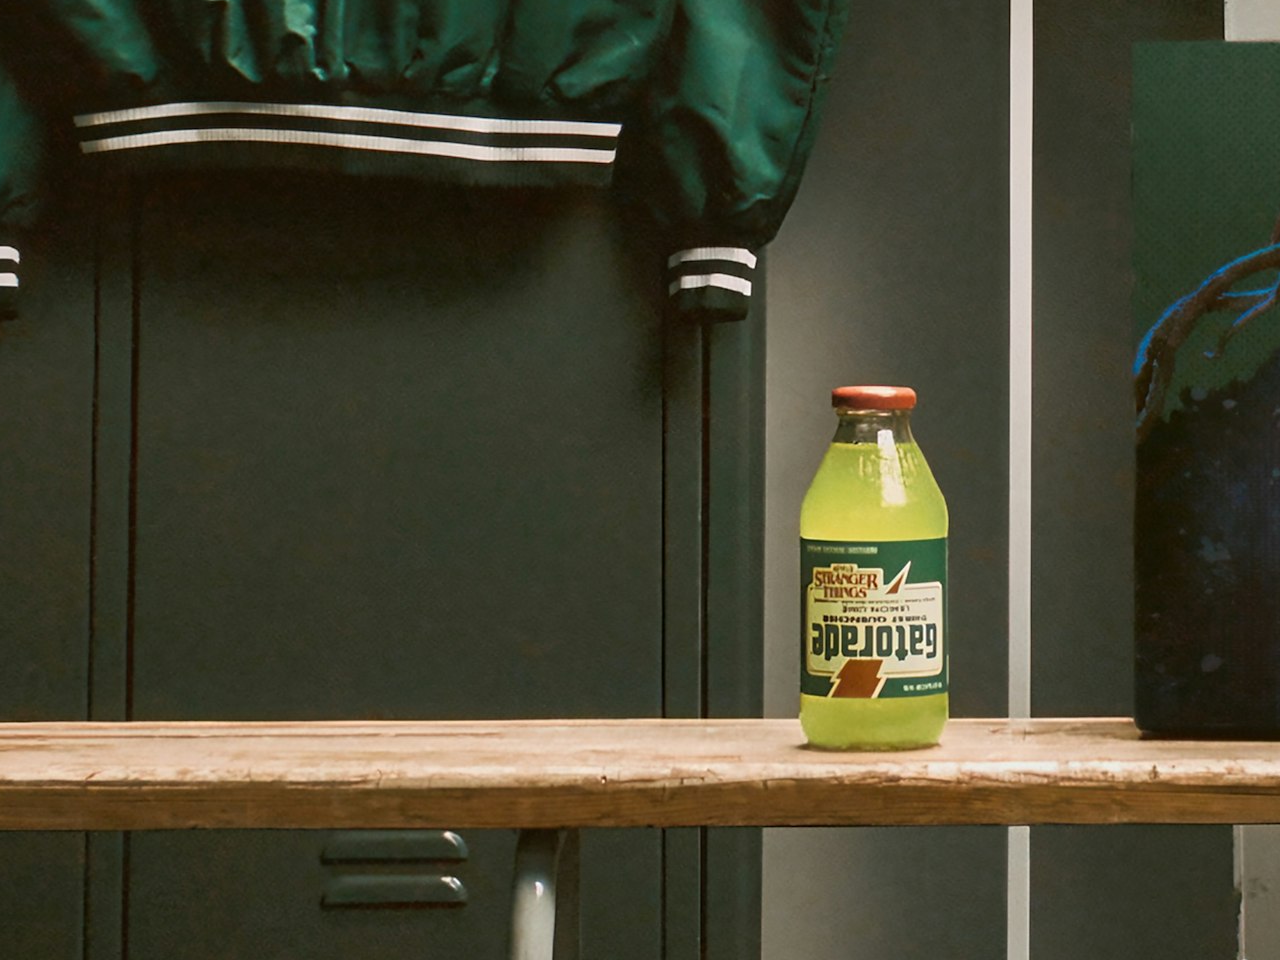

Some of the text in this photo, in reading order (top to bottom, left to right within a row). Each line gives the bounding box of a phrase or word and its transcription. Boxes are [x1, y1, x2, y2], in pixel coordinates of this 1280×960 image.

[814, 572, 878, 590] STRANGER
[823, 586, 867, 598] THINGS
[812, 623, 937, 661] Gatorade
